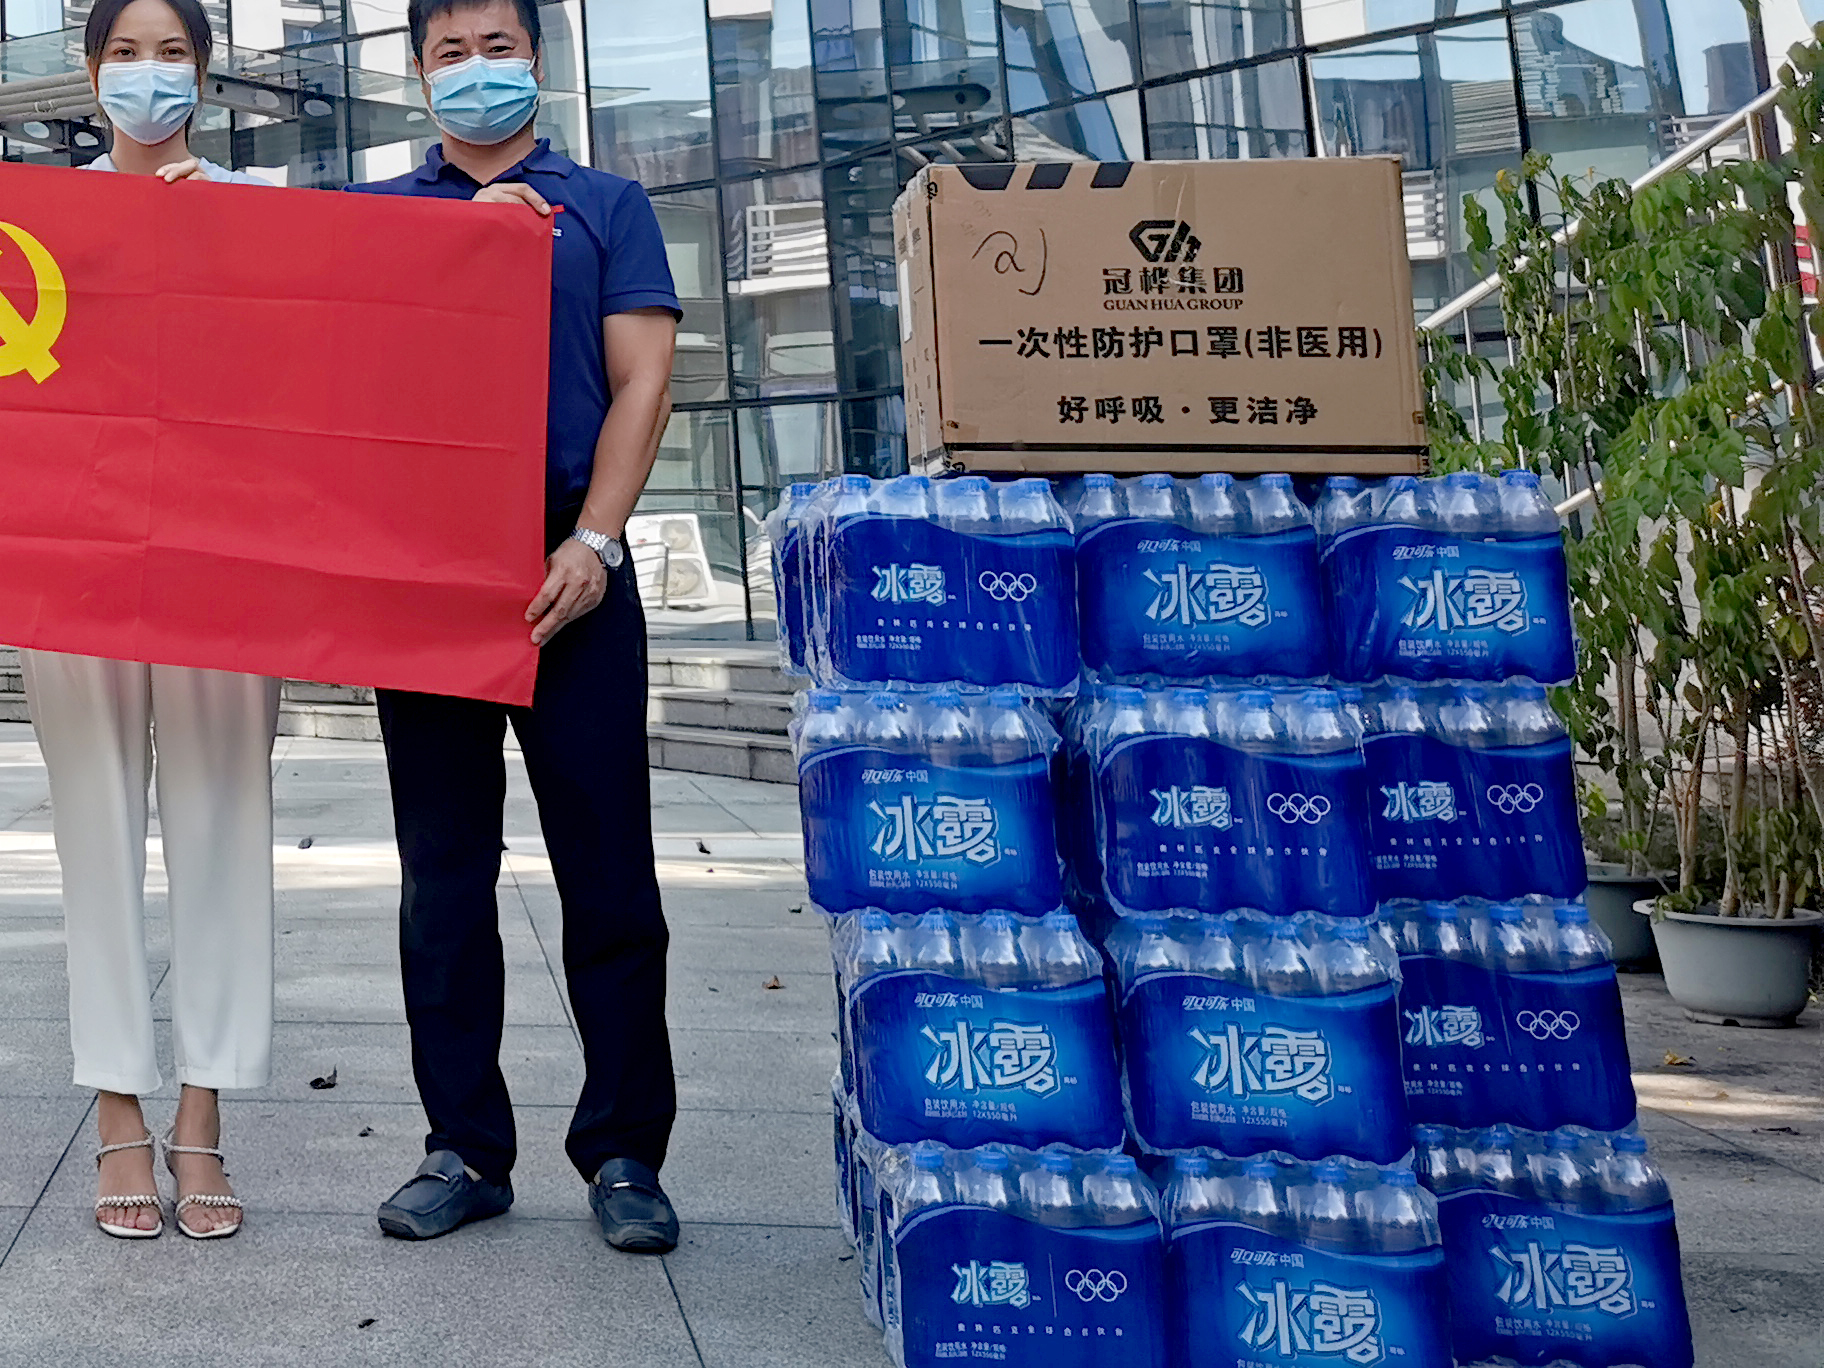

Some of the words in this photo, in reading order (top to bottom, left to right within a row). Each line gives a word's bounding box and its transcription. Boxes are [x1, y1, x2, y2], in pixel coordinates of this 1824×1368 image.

[1102, 267, 1244, 295] 冠桦集团
[1103, 298, 1148, 311] GUAN
[1151, 299, 1185, 311] HUA
[1186, 299, 1244, 311] GROUP
[979, 324, 1382, 359] 一次性防护口罩(非医用)
[870, 562, 946, 607] 冰露
[1143, 563, 1269, 629] 冰露
[1397, 569, 1527, 634] 冰露
[1149, 784, 1233, 831] 冰露
[1380, 781, 1458, 823] 冰露
[867, 795, 999, 866] 冰露
[1402, 1005, 1485, 1049] 冰露
[920, 1020, 1058, 1097] 冰露
[1188, 1024, 1332, 1105] 冰露
[951, 1259, 1031, 1310] 冰露
[1488, 1242, 1636, 1319] 冰露
[1234, 1281, 1385, 1367] 冰露
